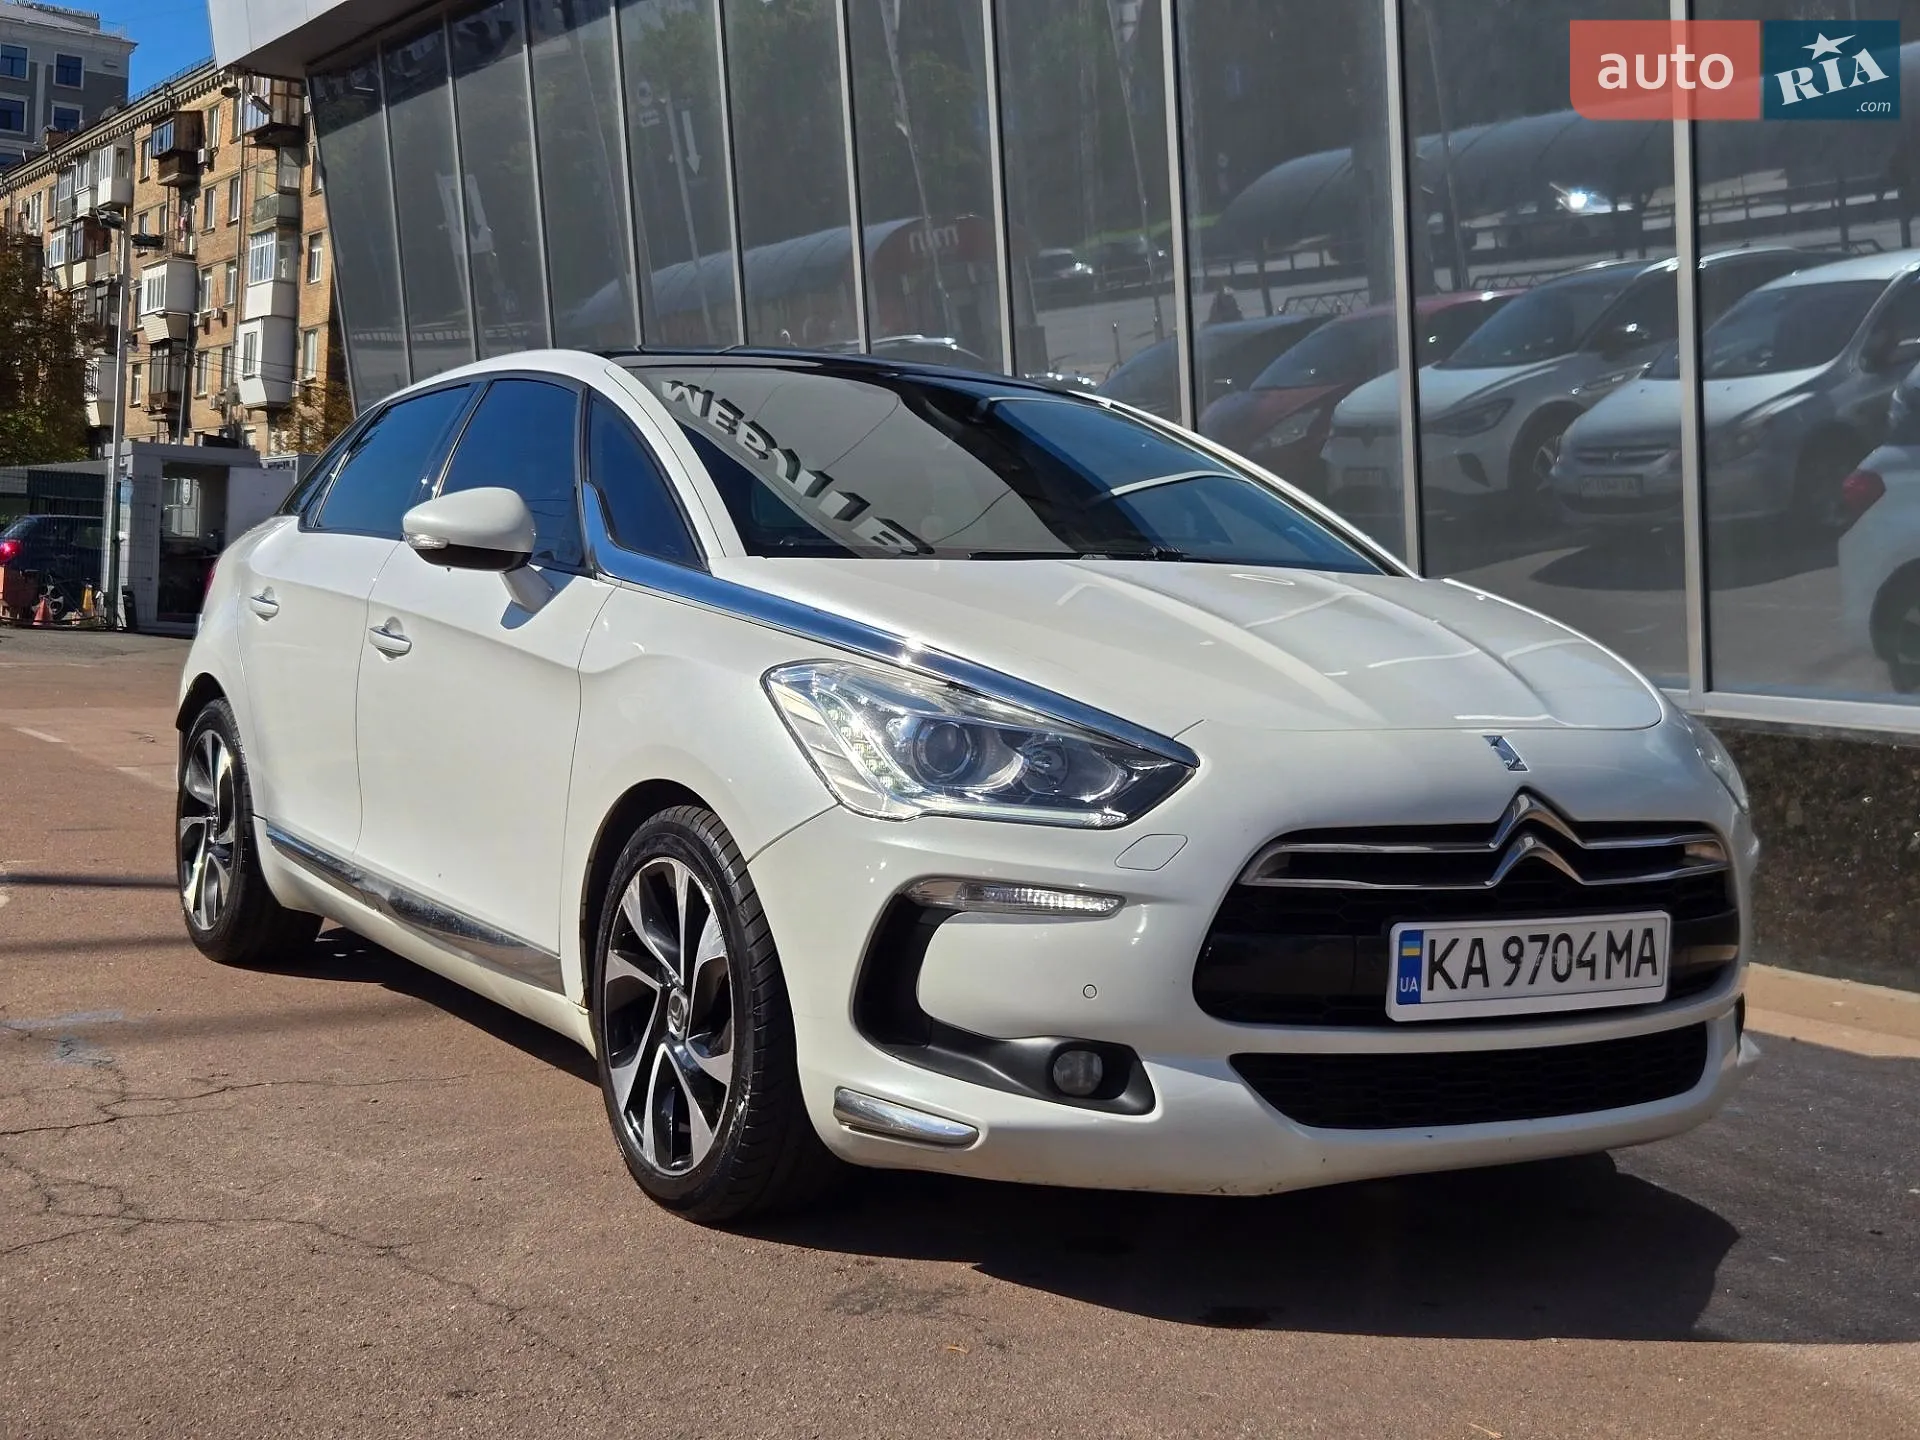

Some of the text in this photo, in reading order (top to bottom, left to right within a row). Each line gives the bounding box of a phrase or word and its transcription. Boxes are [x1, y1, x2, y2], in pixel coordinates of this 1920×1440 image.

[1427, 927, 1658, 991] KA 9704 MA
[1400, 976, 1419, 993] UA
